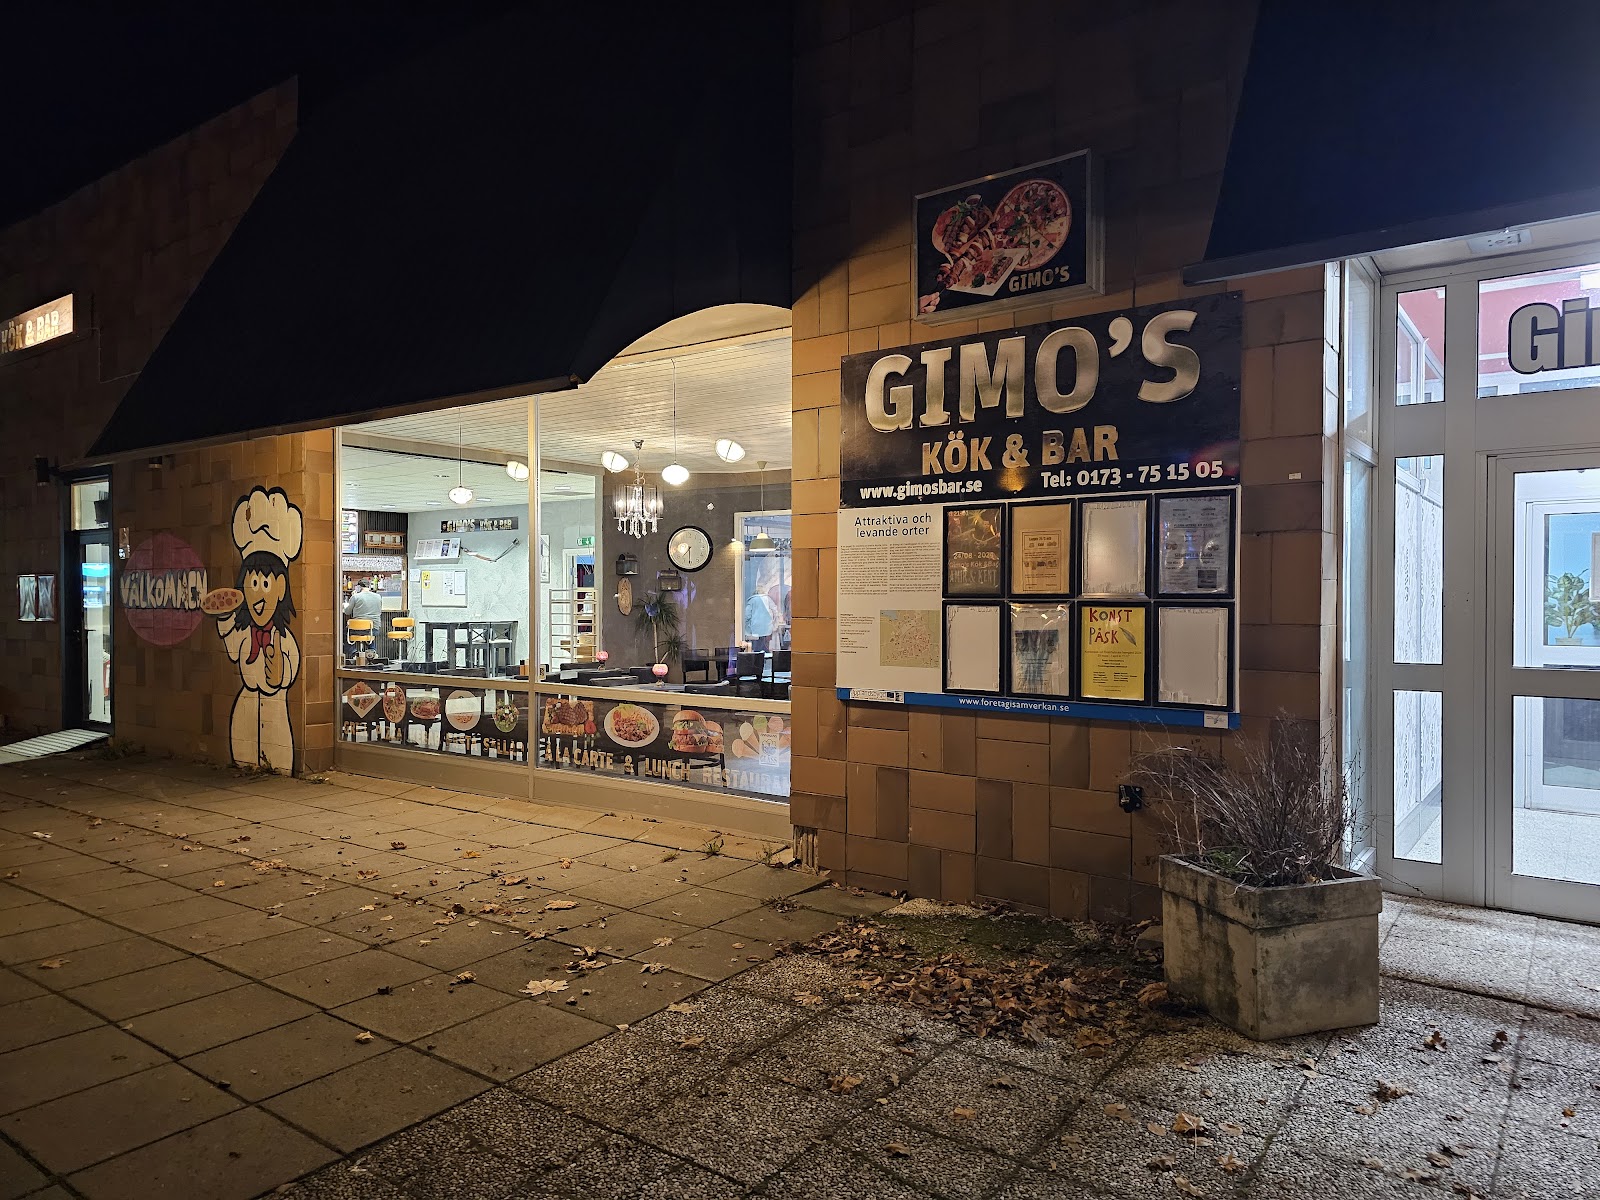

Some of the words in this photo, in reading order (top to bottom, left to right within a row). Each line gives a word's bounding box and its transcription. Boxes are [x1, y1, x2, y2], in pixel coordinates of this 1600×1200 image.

[1009, 265, 1070, 293] GIMO'S
[1, 320, 23, 354] KÖK
[25, 320, 34, 346] &
[36, 310, 59, 341] BAR
[1508, 297, 1600, 374] Gi
[865, 309, 1200, 433] GIMO'S
[922, 430, 993, 476] KÖK
[1001, 433, 1030, 470] &
[1041, 424, 1119, 466] BAR
[1041, 471, 1072, 488] Tel:
[1076, 466, 1121, 486] 0173
[1138, 464, 1161, 484] 75
[1167, 462, 1190, 481] 15
[1195, 460, 1224, 479] 05
[860, 478, 983, 501] www.gimosbar.se
[855, 514, 908, 527] Attraktiva
[912, 512, 932, 524] och
[856, 526, 898, 538] levande
[902, 526, 930, 536] orter
[120, 569, 207, 610] VÄLKOMMEN
[1089, 607, 1132, 622] KONST
[1089, 627, 1119, 645] PÅSK
[959, 698, 1070, 712] www.foretagisamverkan.se
[573, 748, 614, 770] CARTE
[624, 754, 634, 773] &
[644, 757, 690, 781] LUNCH
